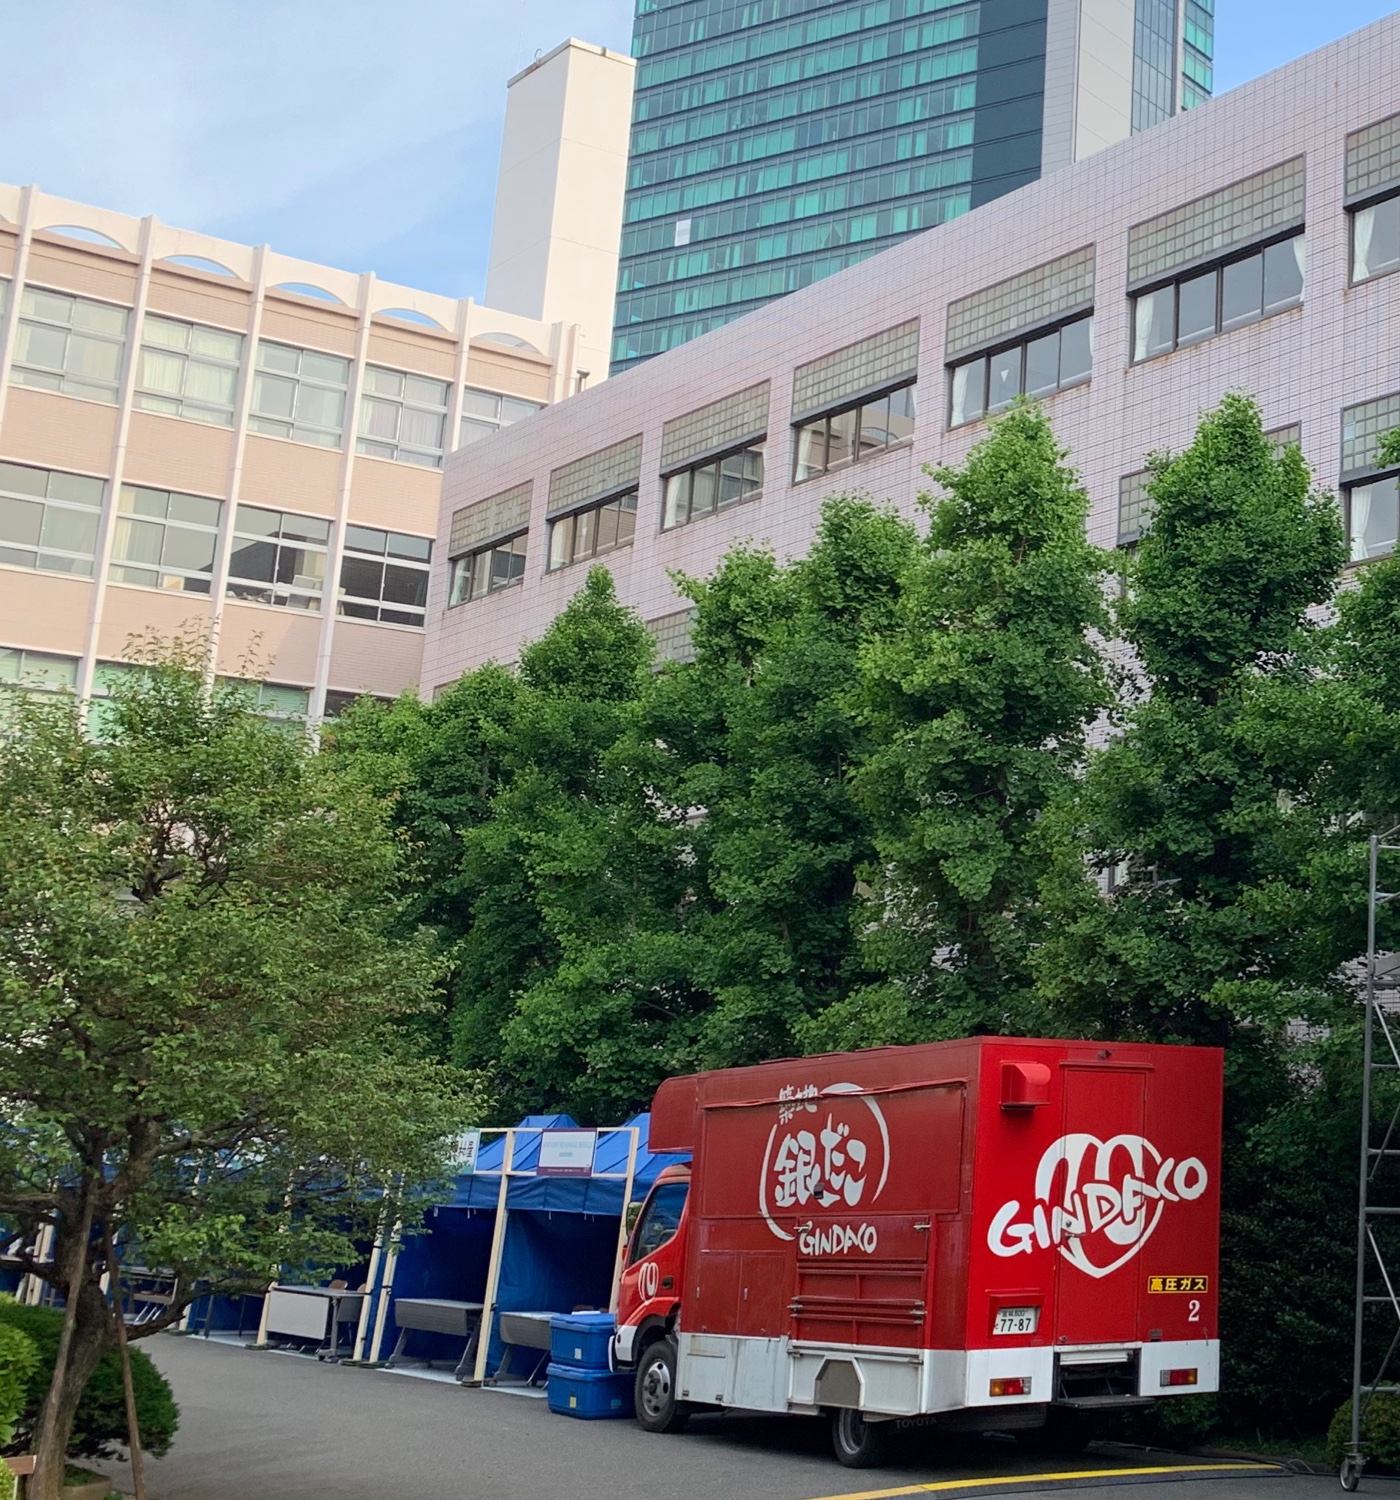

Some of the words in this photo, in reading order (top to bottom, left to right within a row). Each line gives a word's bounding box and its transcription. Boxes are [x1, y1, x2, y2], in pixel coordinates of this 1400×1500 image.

[798, 1220, 878, 1257] GINDACO
[1150, 1277, 1205, 1292] 高圧ガス
[1188, 1299, 1201, 1322] 2
[1000, 1317, 1032, 1333] 77-87
[895, 1416, 938, 1429] TOYOTA
